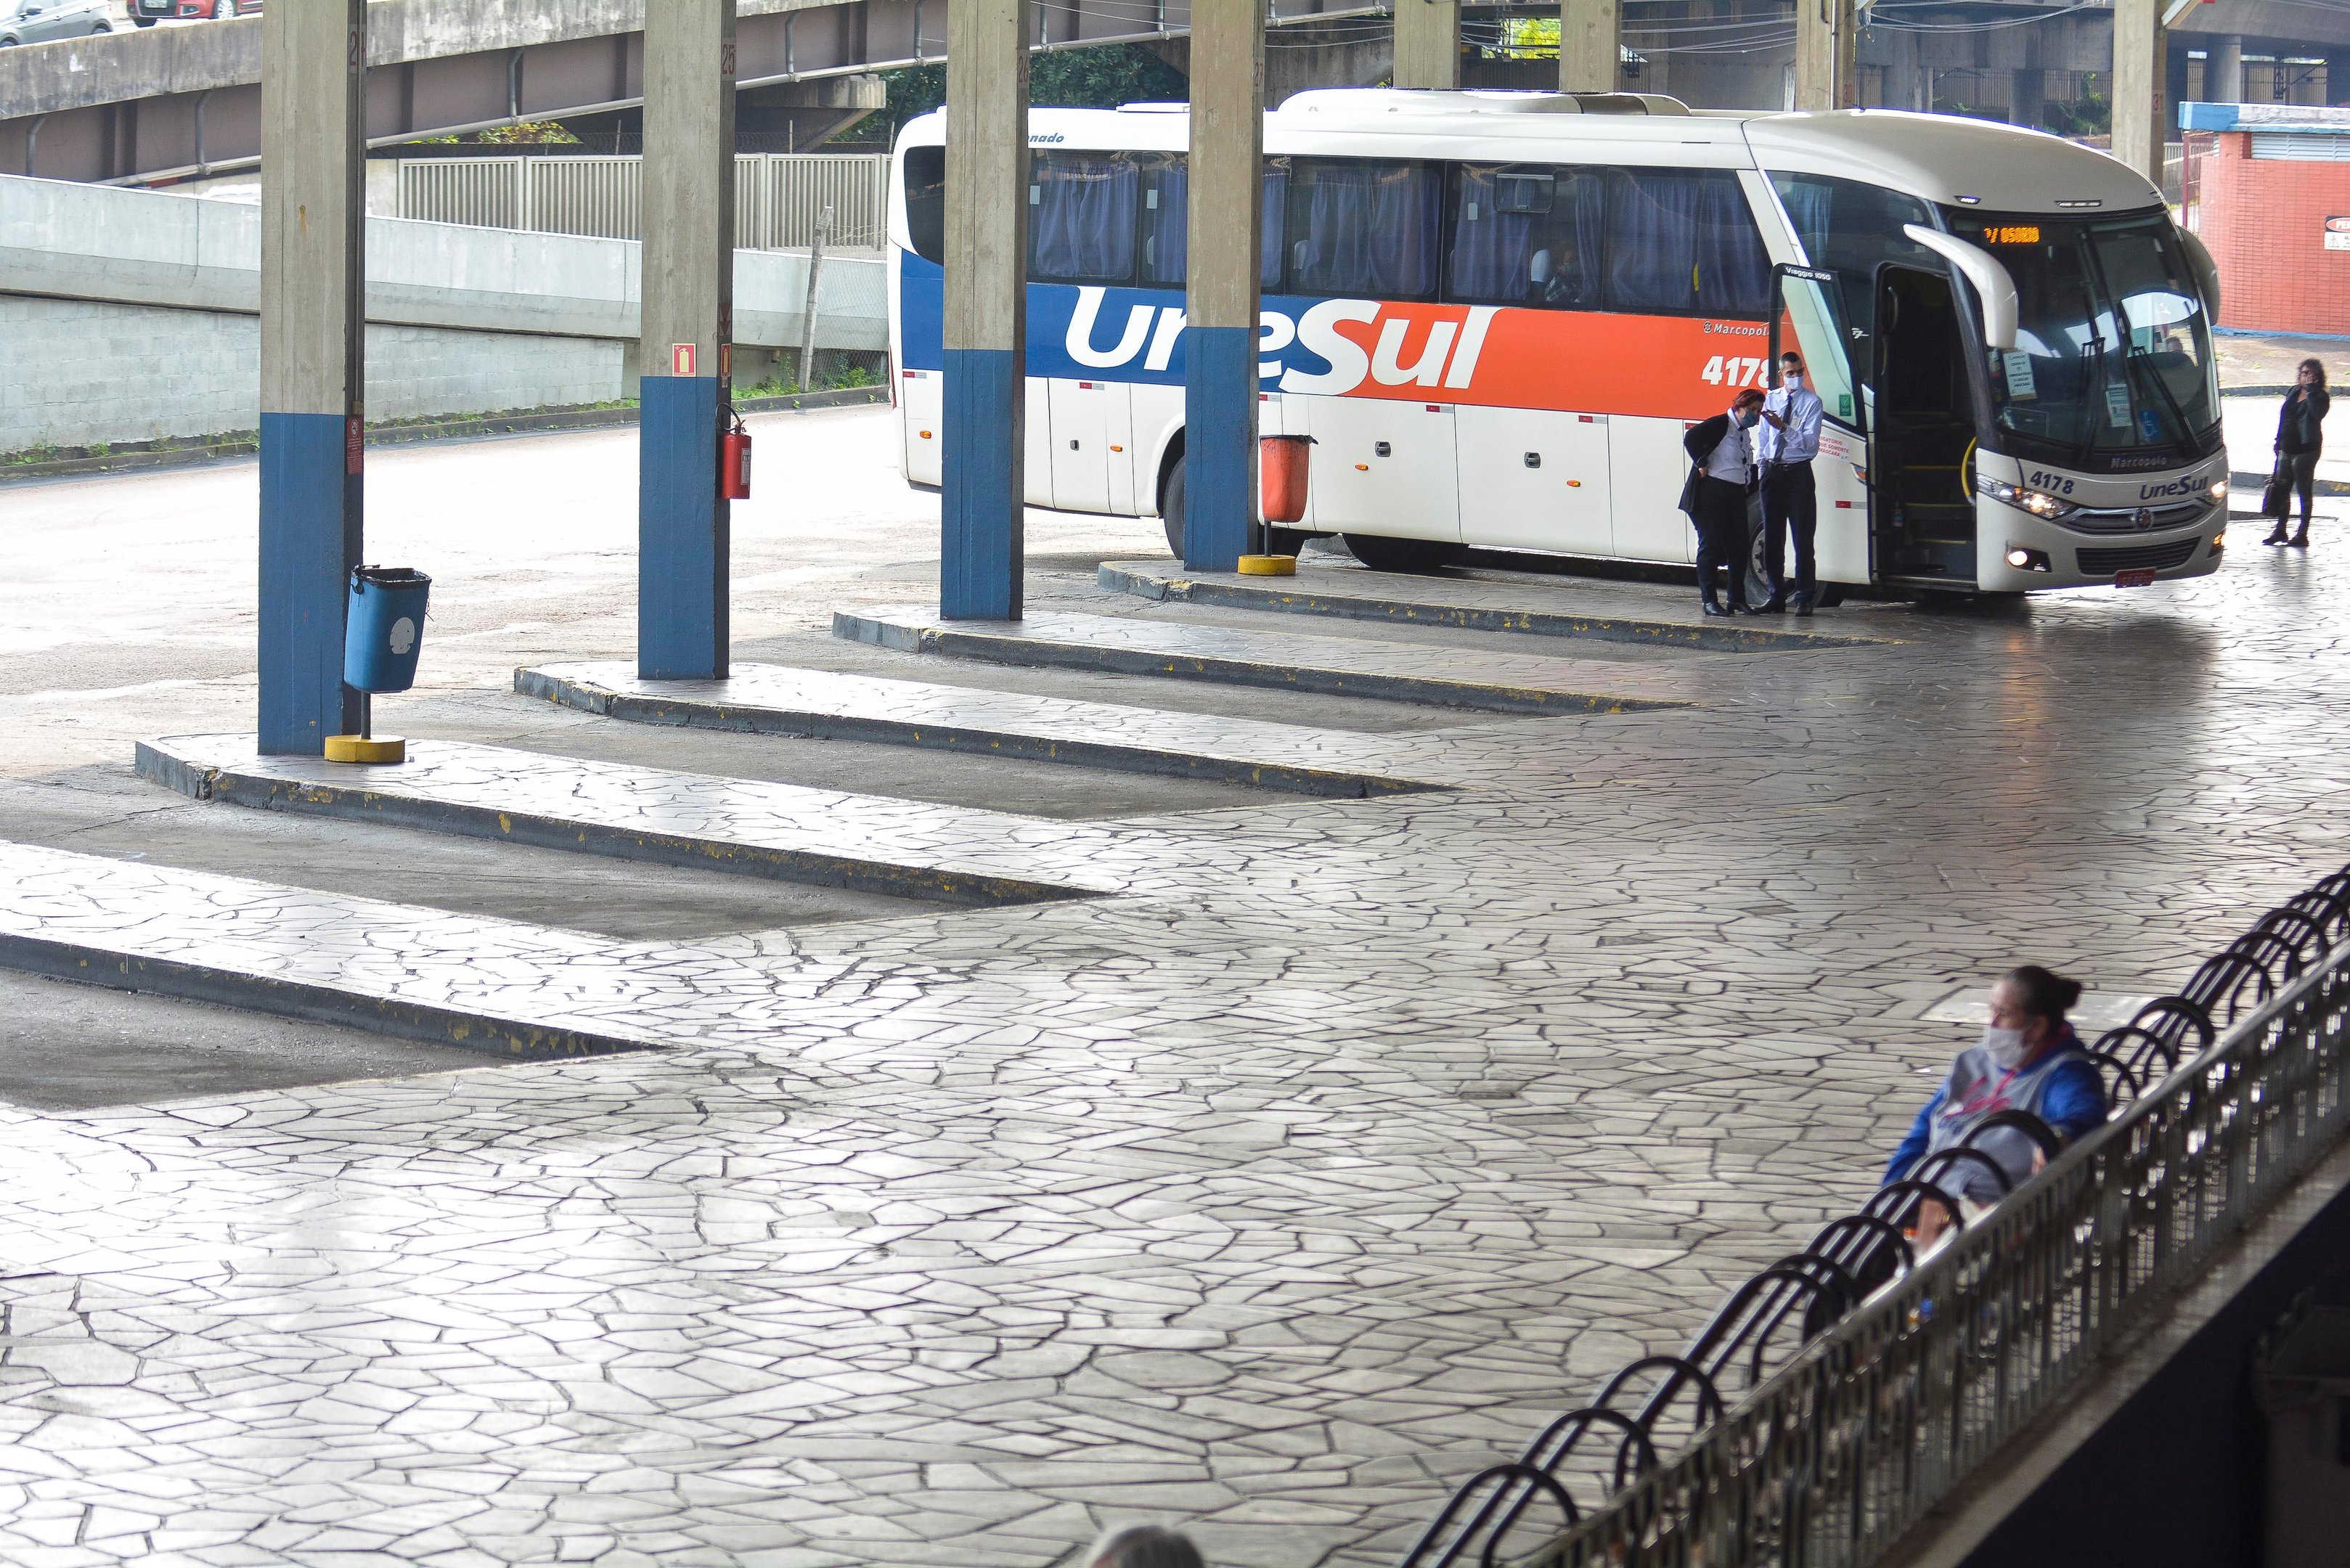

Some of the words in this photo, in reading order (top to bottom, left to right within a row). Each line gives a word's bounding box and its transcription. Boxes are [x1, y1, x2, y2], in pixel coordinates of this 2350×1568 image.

[1019, 56, 1029, 83] 26
[1027, 132, 1064, 143] nado
[1785, 266, 1814, 278] Viaggio
[1815, 272, 1832, 281] 1050
[1714, 323, 1769, 337] Marcopol
[2110, 457, 2166, 468] Marcopolo
[2030, 471, 2074, 495] 4178
[2139, 475, 2208, 500] UneSul
